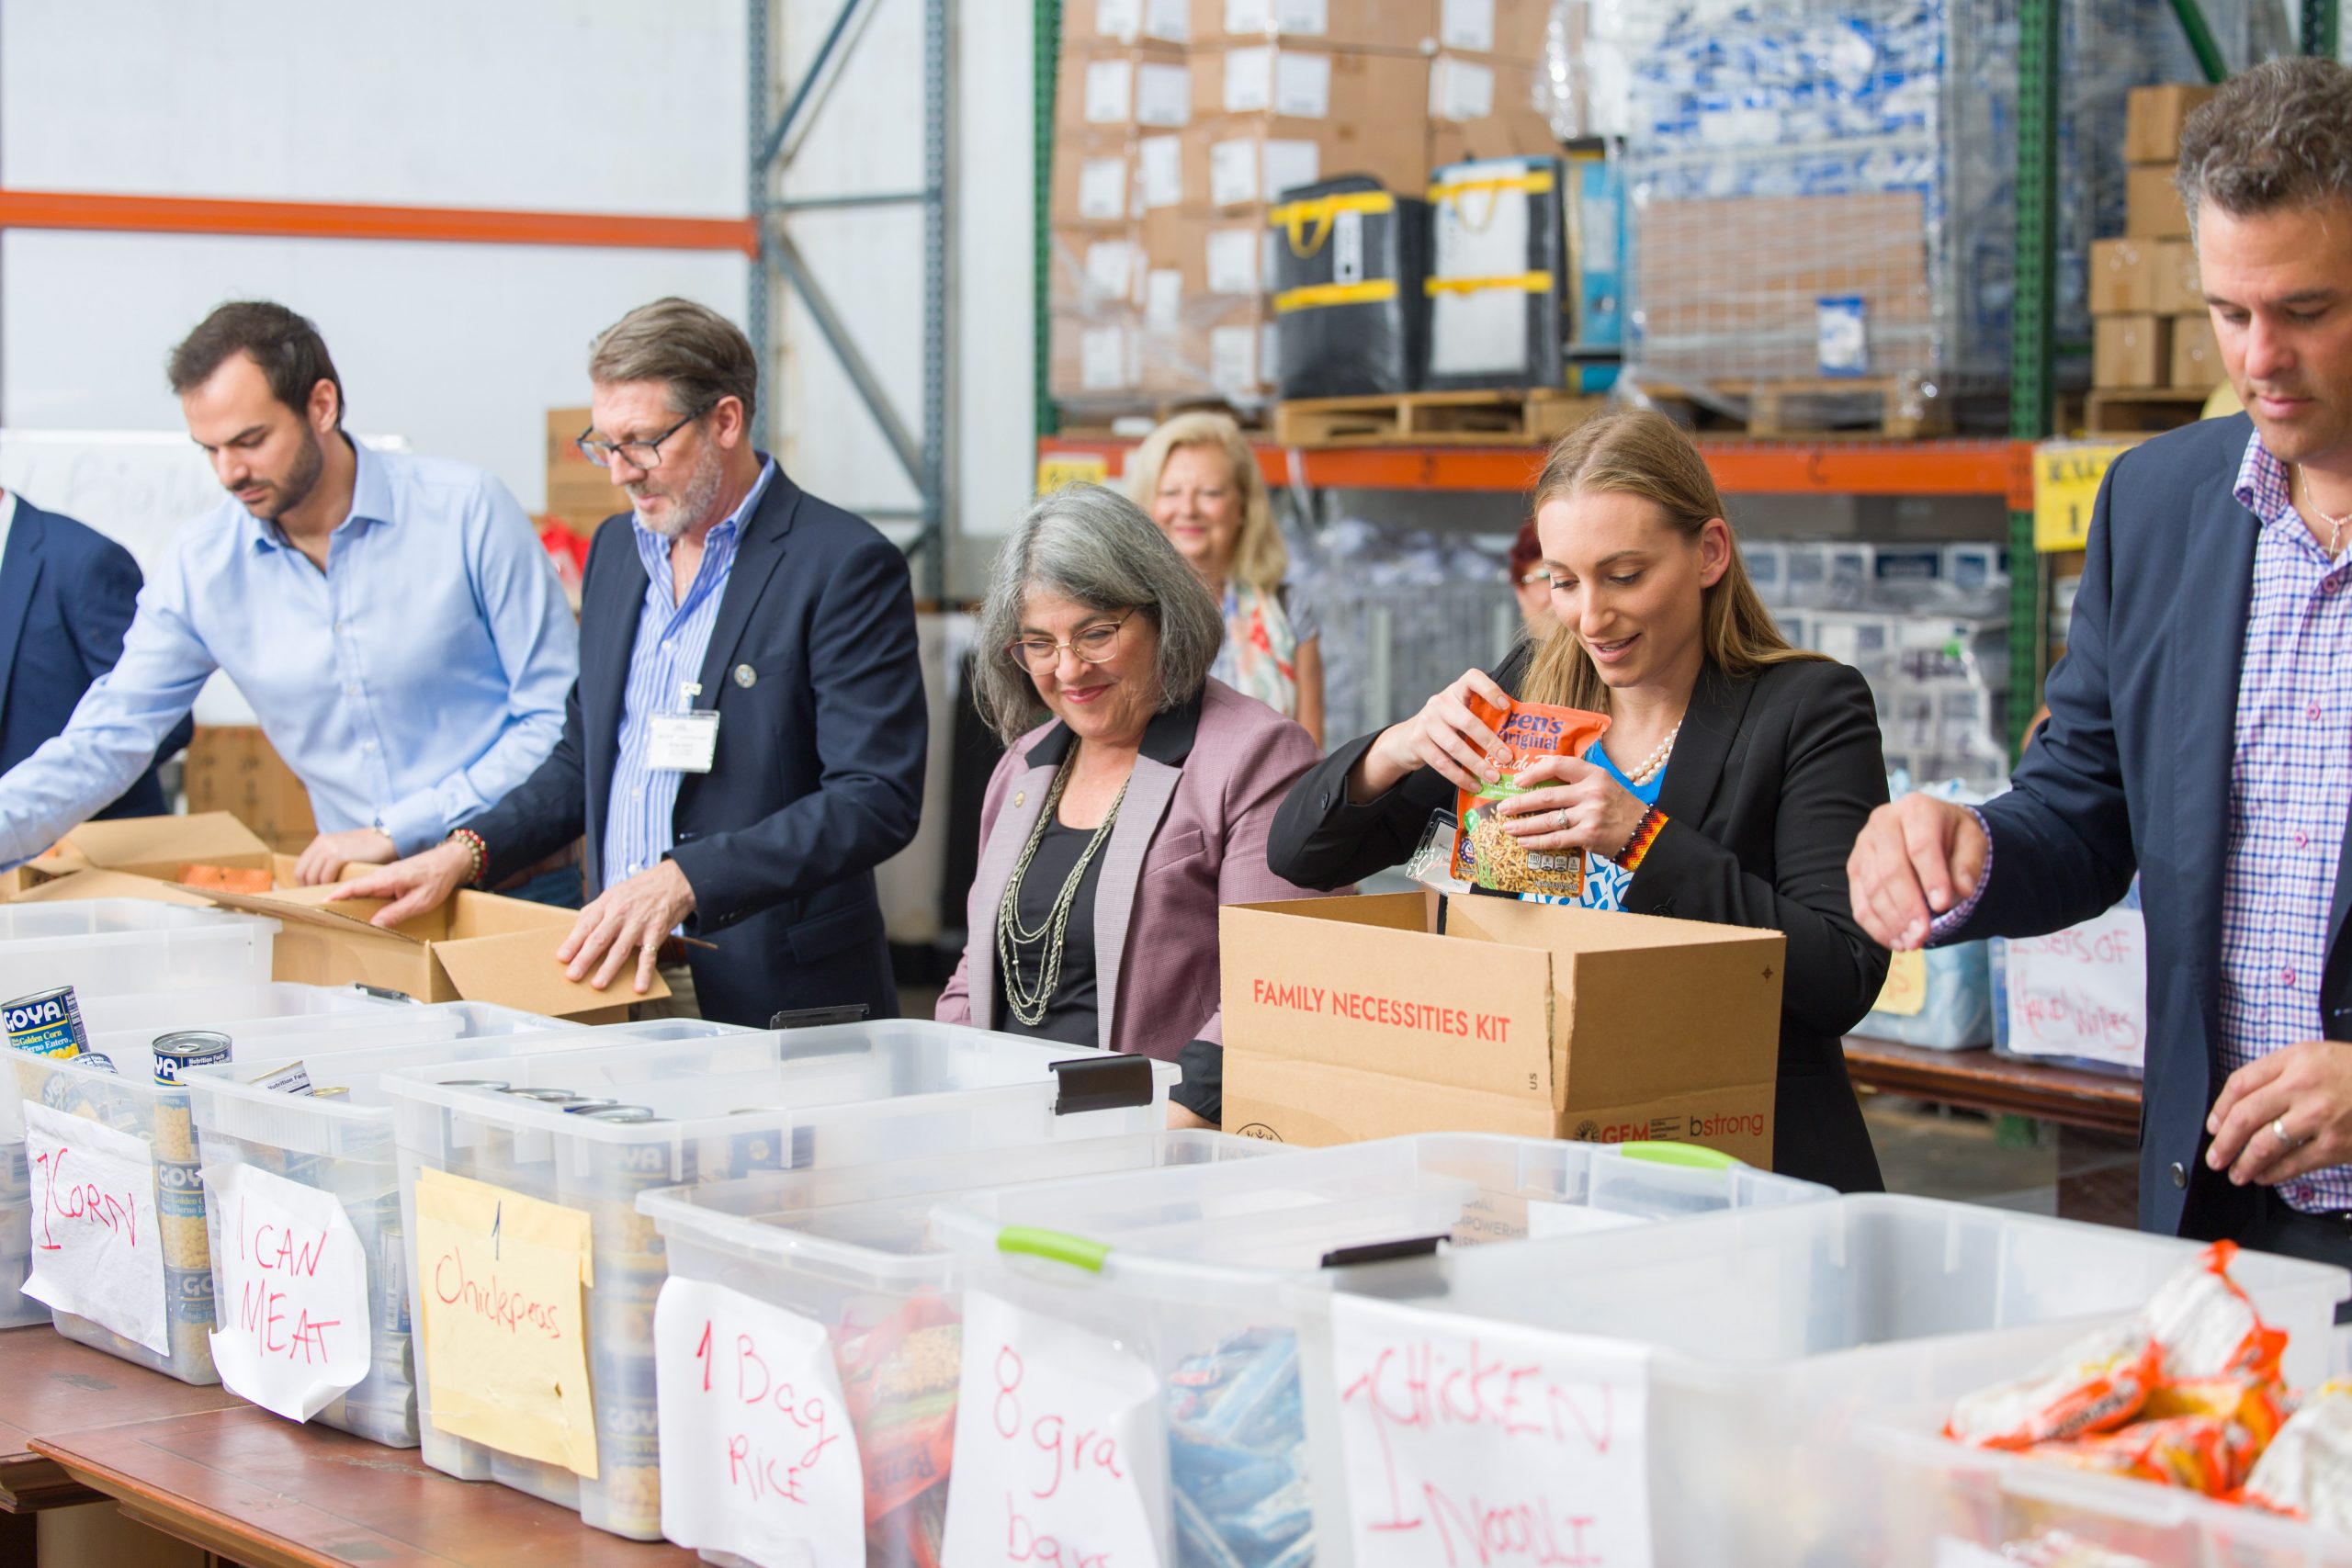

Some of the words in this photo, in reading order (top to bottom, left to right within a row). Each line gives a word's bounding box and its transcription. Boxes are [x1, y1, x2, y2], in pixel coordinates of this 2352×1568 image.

[4, 1001, 62, 1032] GOYA
[43, 1030, 62, 1040] Corn
[1254, 979, 1326, 1014] FAMILY
[1332, 992, 1469, 1038] NECESSITIES
[1476, 1014, 1512, 1043] KIT
[267, 1077, 294, 1090] Nutrition
[1529, 1072, 1538, 1090] US
[1690, 1113, 1764, 1137] bstrong
[255, 1224, 328, 1278] CAN
[492, 1200, 502, 1261] 1
[241, 1280, 342, 1365] MEAT
[436, 1246, 560, 1338] Chickpeas
[695, 1320, 713, 1393] 1
[737, 1334, 840, 1470] Bag
[992, 1343, 1025, 1440] 8
[1030, 1414, 1125, 1500] gra
